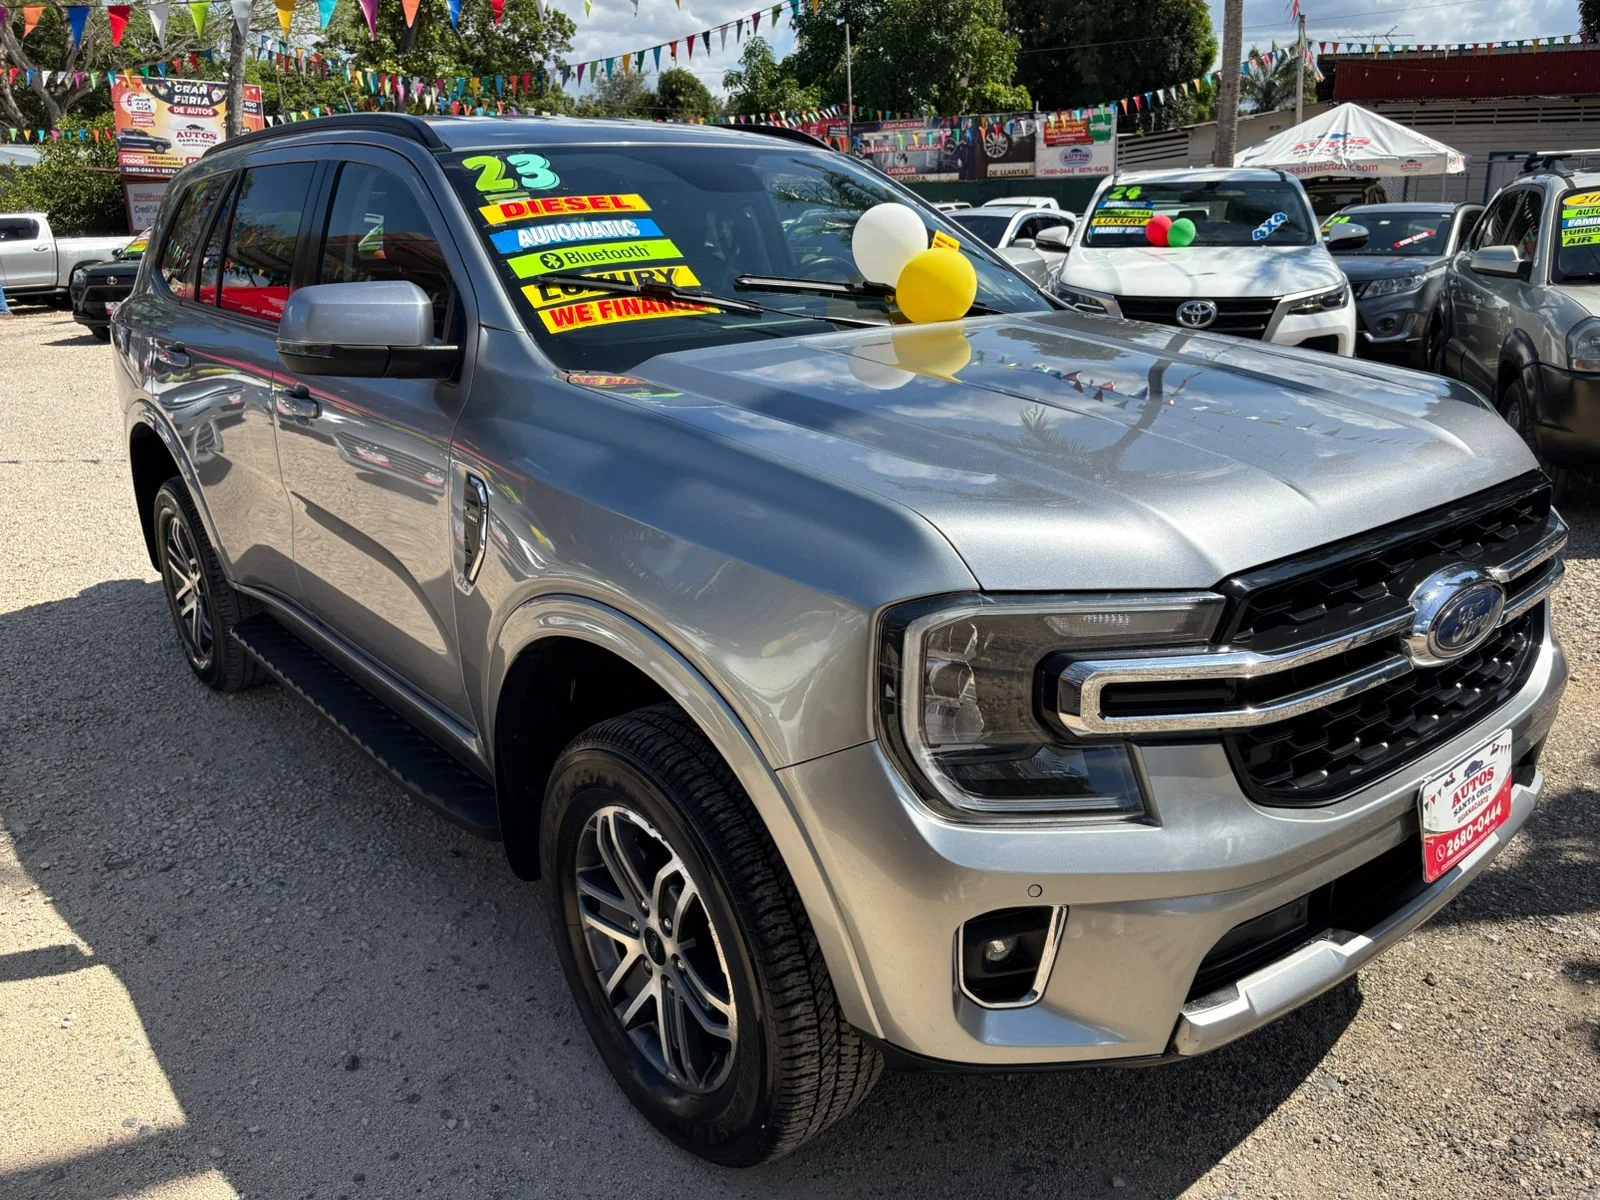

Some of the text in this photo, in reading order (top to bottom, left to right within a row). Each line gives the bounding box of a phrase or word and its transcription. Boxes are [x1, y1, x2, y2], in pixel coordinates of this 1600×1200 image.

[174, 84, 208, 94] GRAN
[174, 95, 210, 106] FERIA
[188, 107, 214, 116] AUTOS
[176, 132, 217, 140] AUTOS
[462, 154, 560, 192] 23
[1108, 186, 1142, 200] 24
[500, 196, 633, 219] DIESEL
[517, 219, 641, 248] AUTOMATIC
[1565, 236, 1593, 245] AIR
[564, 245, 650, 265] Bluetooth
[550, 302, 595, 328] WE
[1451, 599, 1494, 643] Ford
[1452, 766, 1494, 809] AUTOS
[1453, 783, 1493, 817] SANTA CRUZ
[1457, 795, 1490, 823] GUANACASTE
[1446, 799, 1502, 857] 2680-0444
